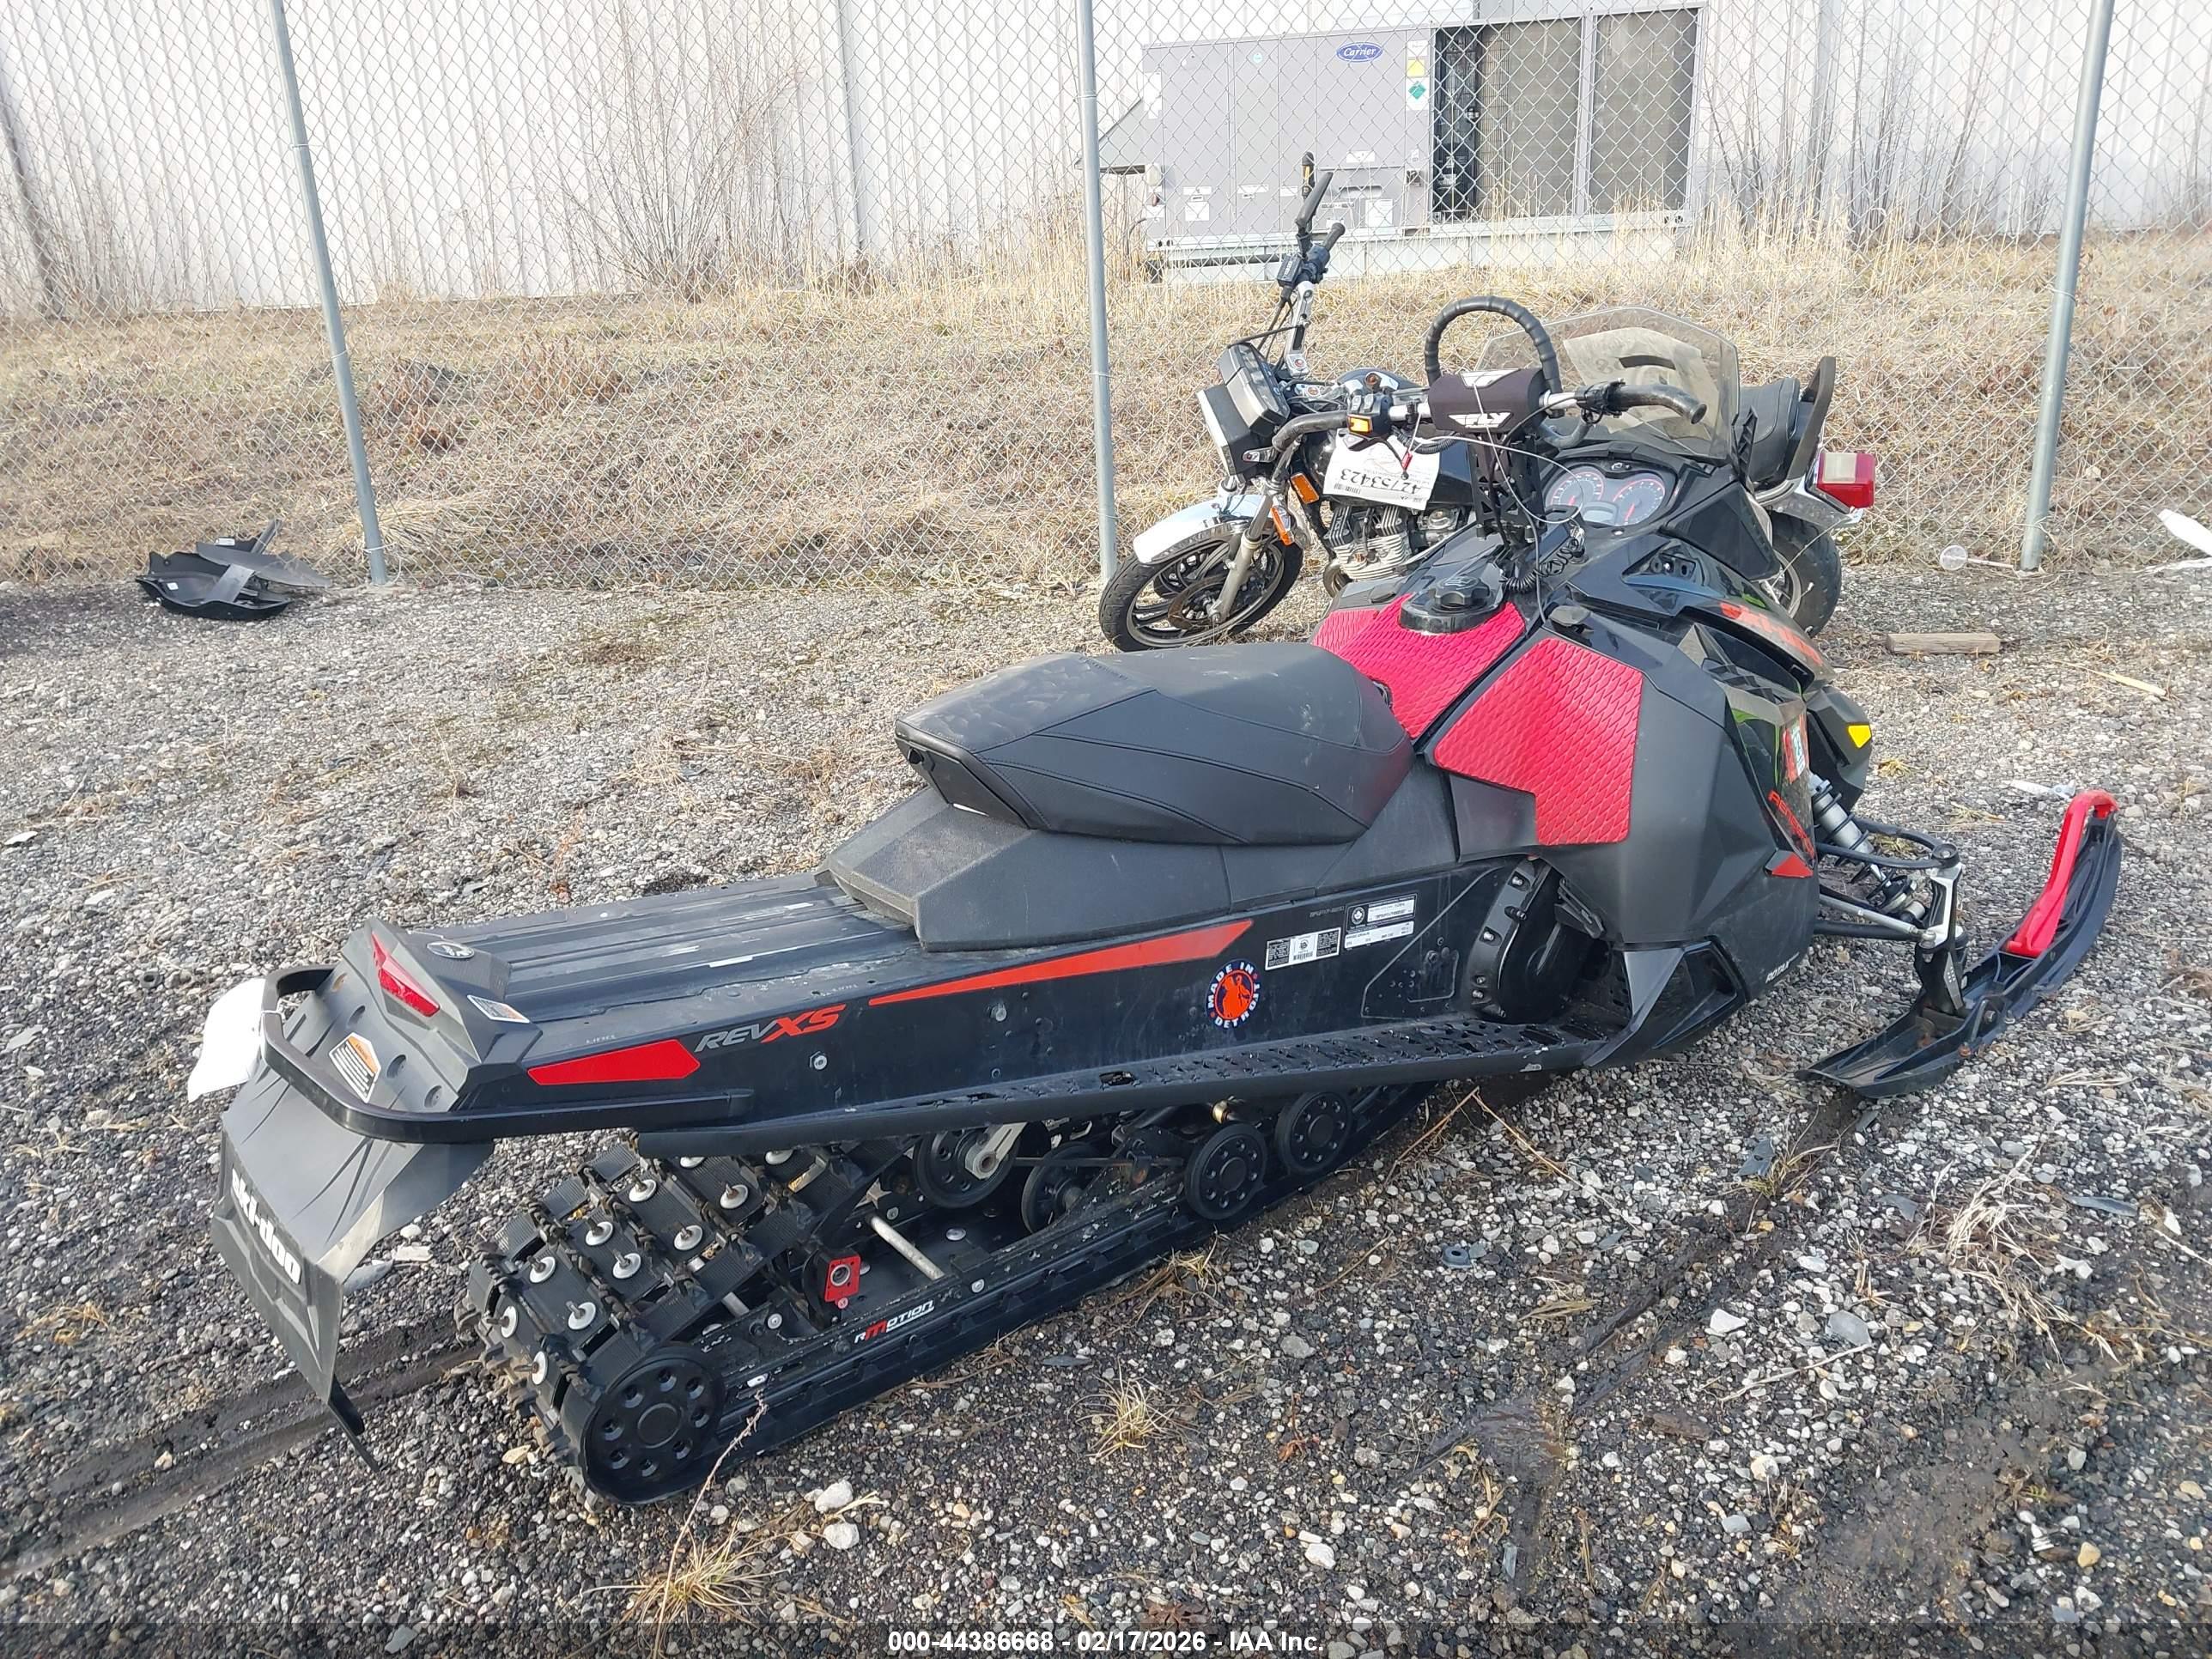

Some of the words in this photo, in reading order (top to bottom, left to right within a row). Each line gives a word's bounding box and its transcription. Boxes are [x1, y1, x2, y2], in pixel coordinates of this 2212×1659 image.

[1343, 46, 1377, 57] Carrier
[1207, 963, 1233, 1009] MADE
[1239, 962, 1255, 975] IN
[1214, 981, 1261, 1029] DETROIT
[231, 1167, 302, 1285] ski-doo
